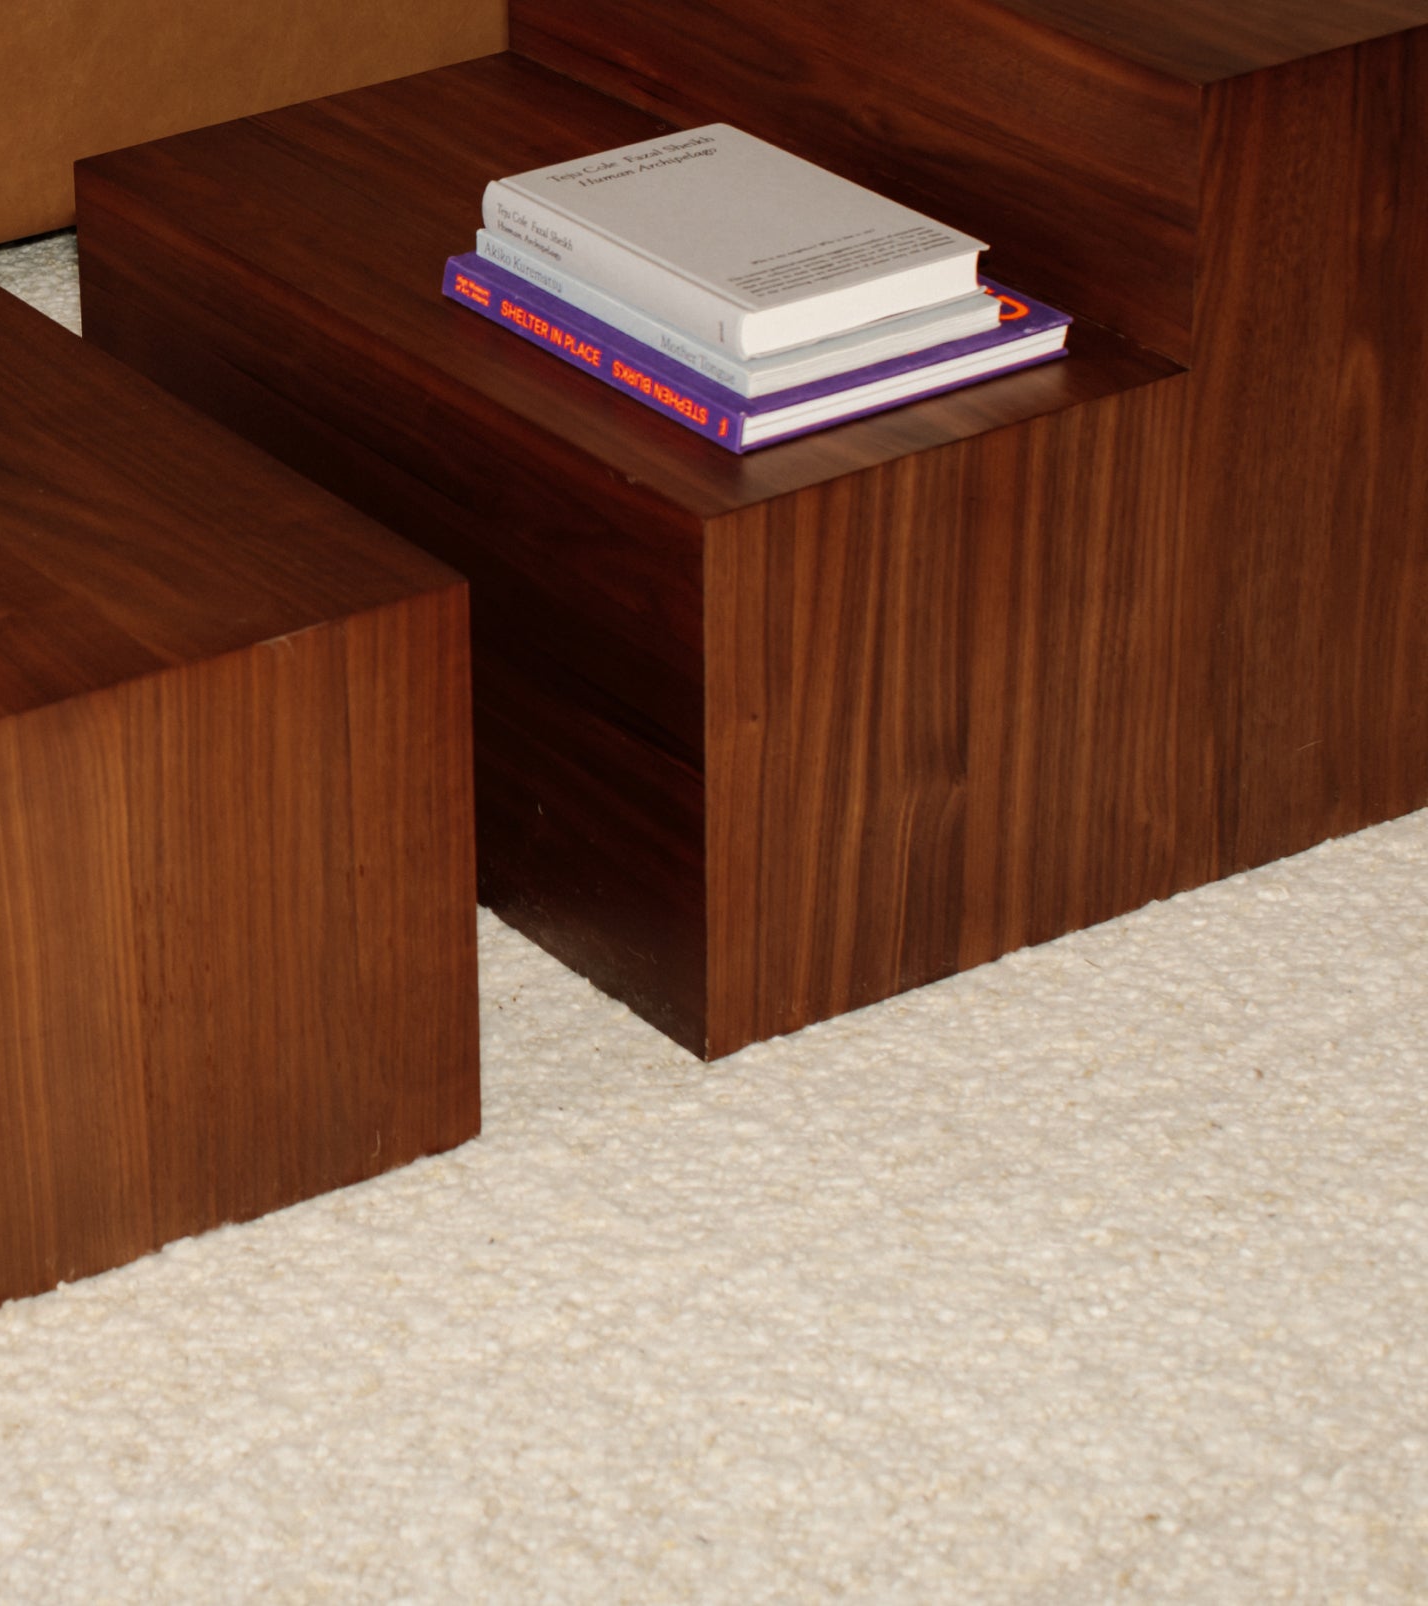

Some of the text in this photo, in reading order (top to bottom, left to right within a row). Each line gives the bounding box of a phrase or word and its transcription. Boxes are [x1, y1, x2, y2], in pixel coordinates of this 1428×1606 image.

[578, 147, 718, 187] Human Archipelago
[583, 161, 618, 173] Cole
[623, 149, 663, 163] Fazal
[662, 136, 715, 153] Sheikh
[484, 241, 511, 265] Akiko
[500, 299, 603, 368] SHELTER IN PLACE
[612, 359, 710, 426] STEPHEN BURKS
